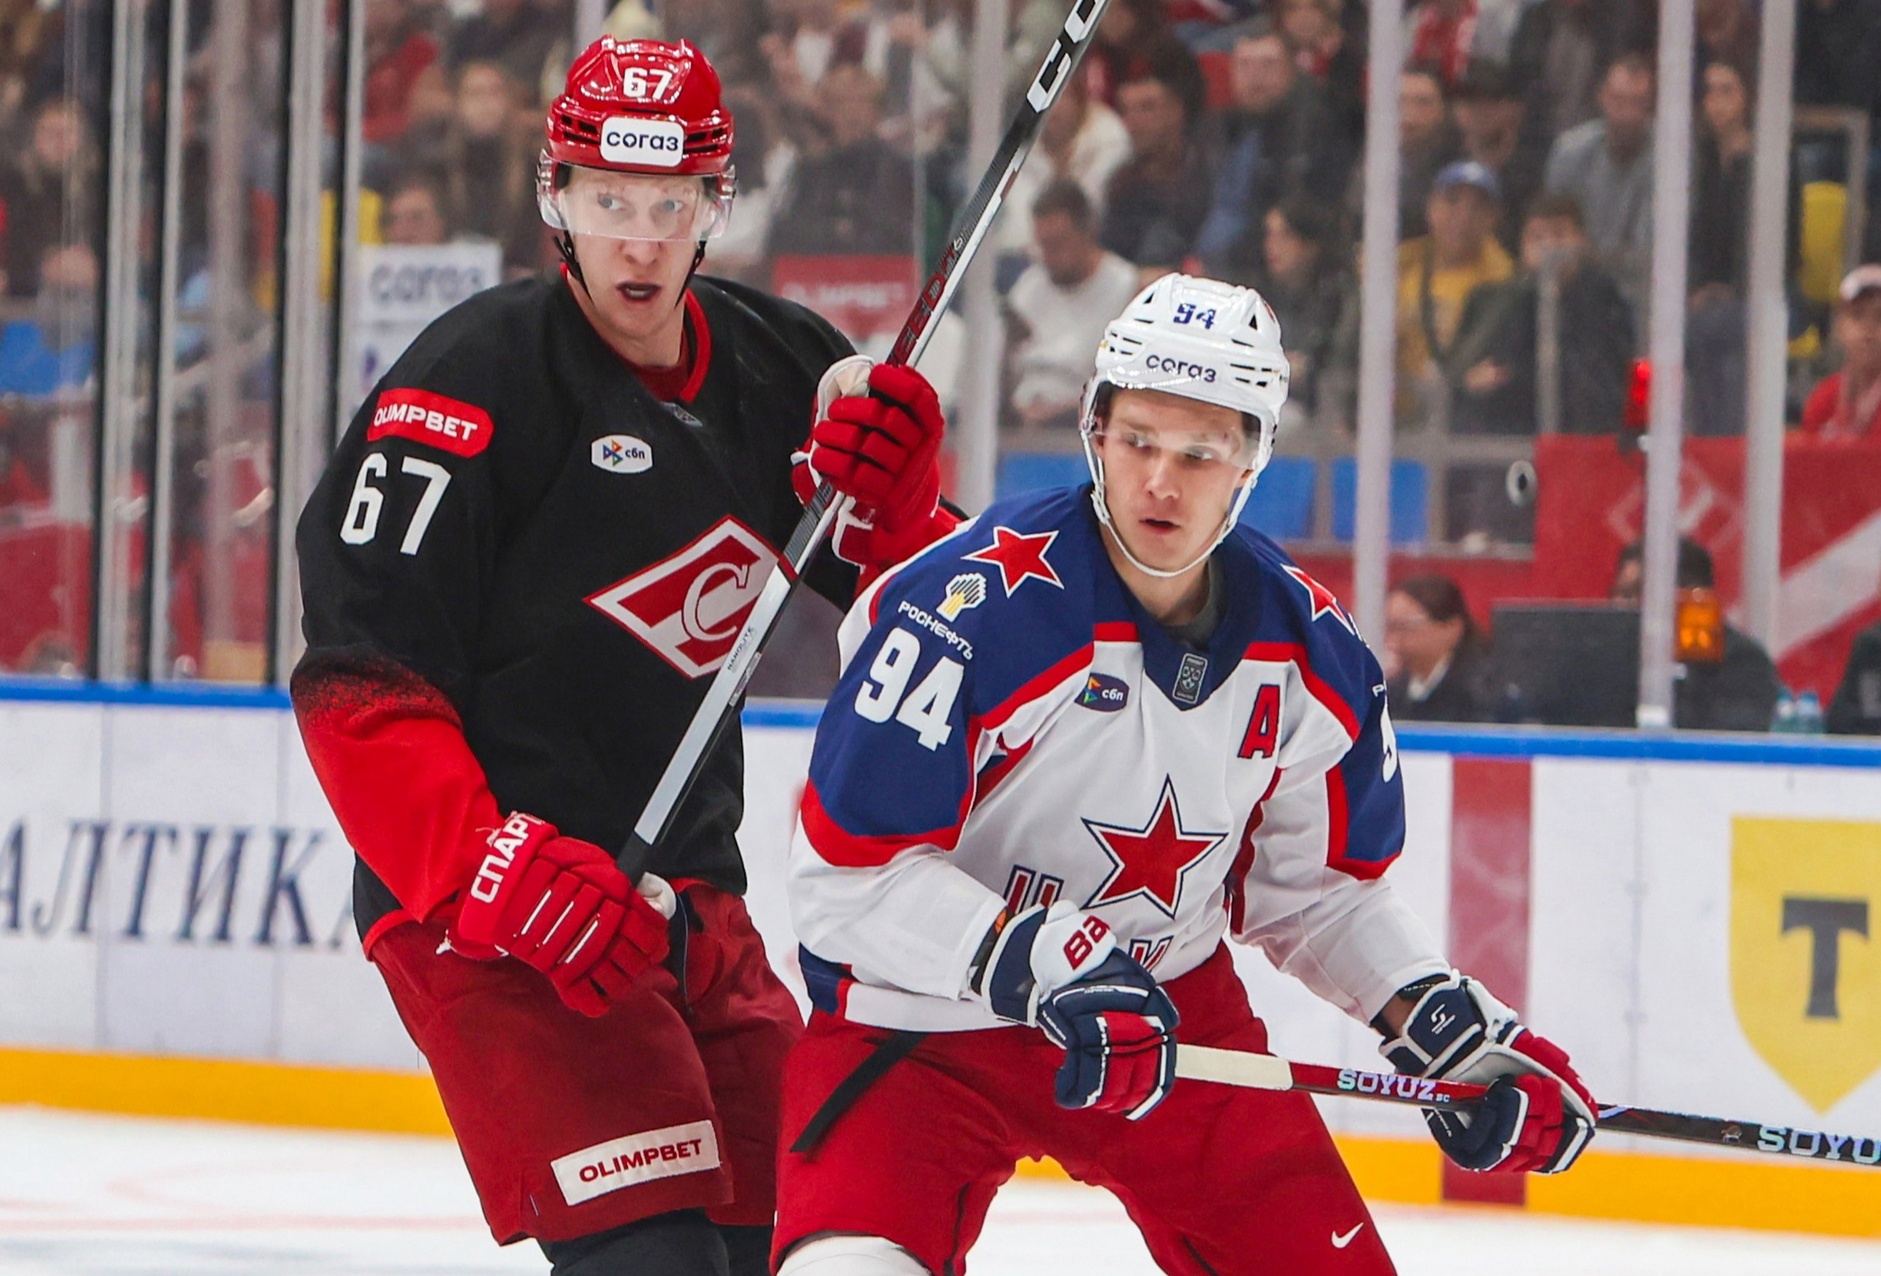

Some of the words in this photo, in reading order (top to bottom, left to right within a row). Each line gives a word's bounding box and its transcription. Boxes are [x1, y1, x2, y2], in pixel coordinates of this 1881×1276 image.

[623, 66, 673, 100] 67
[606, 131, 679, 151] согаз
[1173, 303, 1216, 329] 94
[1145, 354, 1217, 383] согаз
[373, 403, 478, 441] OLIMPBET
[625, 447, 645, 459] сбп
[339, 452, 452, 556] 67
[898, 600, 973, 660] РОСНЕФТЬ
[854, 626, 965, 752] 94
[1101, 688, 1124, 701] сбп
[1237, 684, 1280, 759] A
[1337, 1068, 1437, 1101] SOYUZ
[579, 1139, 701, 1182] OLIMPBET
[1757, 1125, 1881, 1164] SOYU
